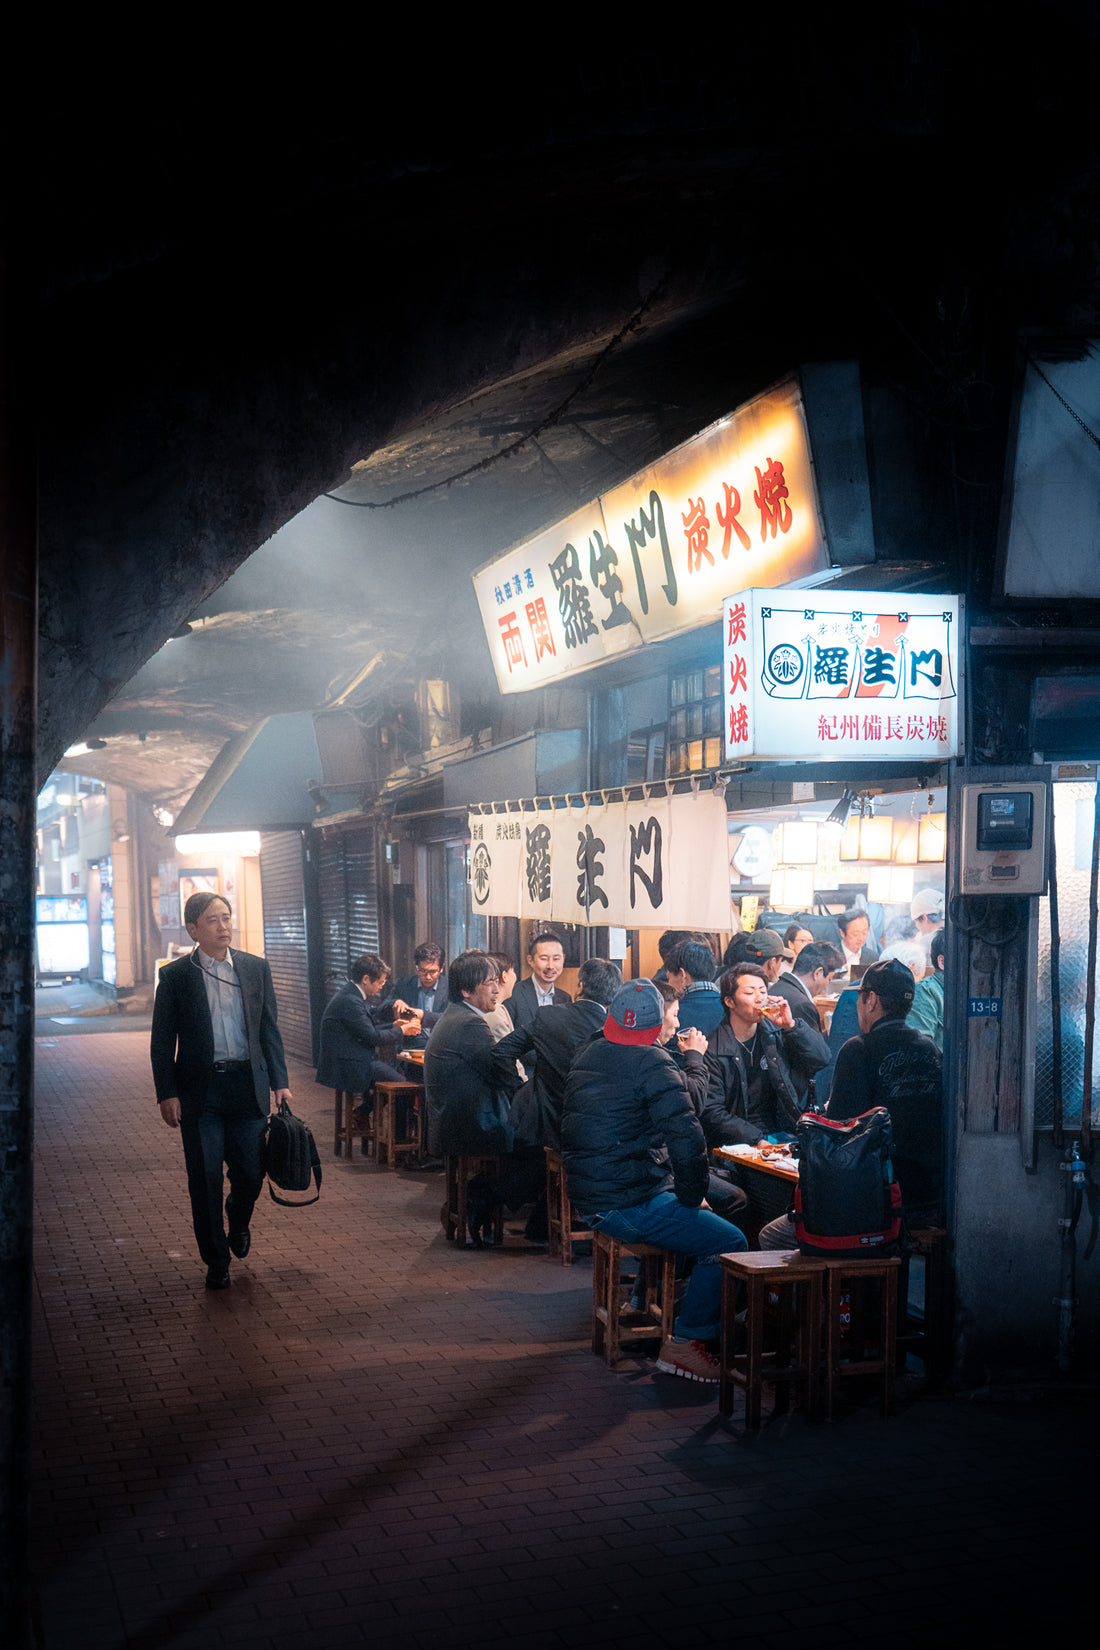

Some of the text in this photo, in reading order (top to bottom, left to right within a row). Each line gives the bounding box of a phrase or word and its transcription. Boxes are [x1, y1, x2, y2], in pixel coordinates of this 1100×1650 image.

[682, 458, 793, 574] 炭火焼
[495, 568, 534, 605] 秋田清酒
[549, 490, 677, 648] 羅生門
[728, 602, 748, 744] 炭火焼
[814, 645, 942, 687] 羅生門
[818, 715, 947, 741] 紀州備長炭焼
[526, 816, 663, 909] 羅生門
[624, 1009, 637, 1028] B
[971, 1002, 998, 1013] 13-8
